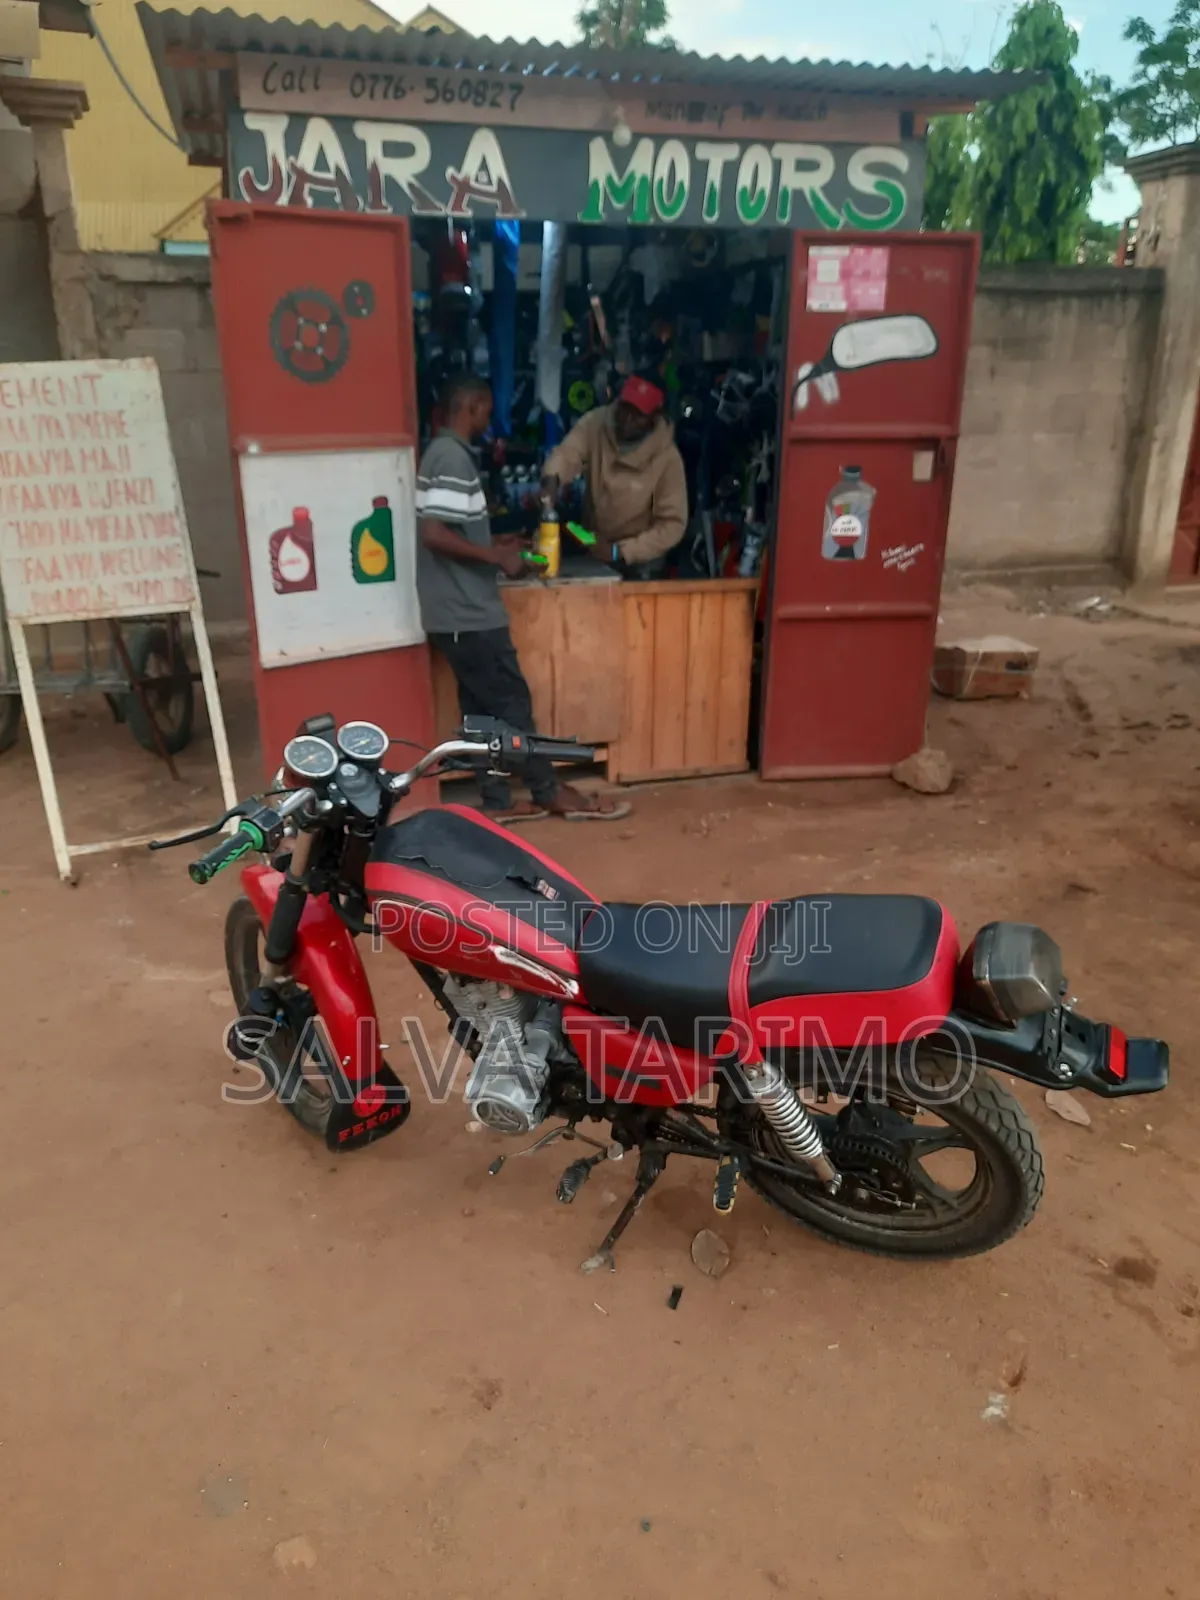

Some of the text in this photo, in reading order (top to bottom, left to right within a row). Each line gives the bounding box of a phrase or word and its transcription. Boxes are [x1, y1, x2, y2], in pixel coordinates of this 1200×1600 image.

[262, 62, 321, 95] Call
[239, 112, 909, 231] JARA MOTORS
